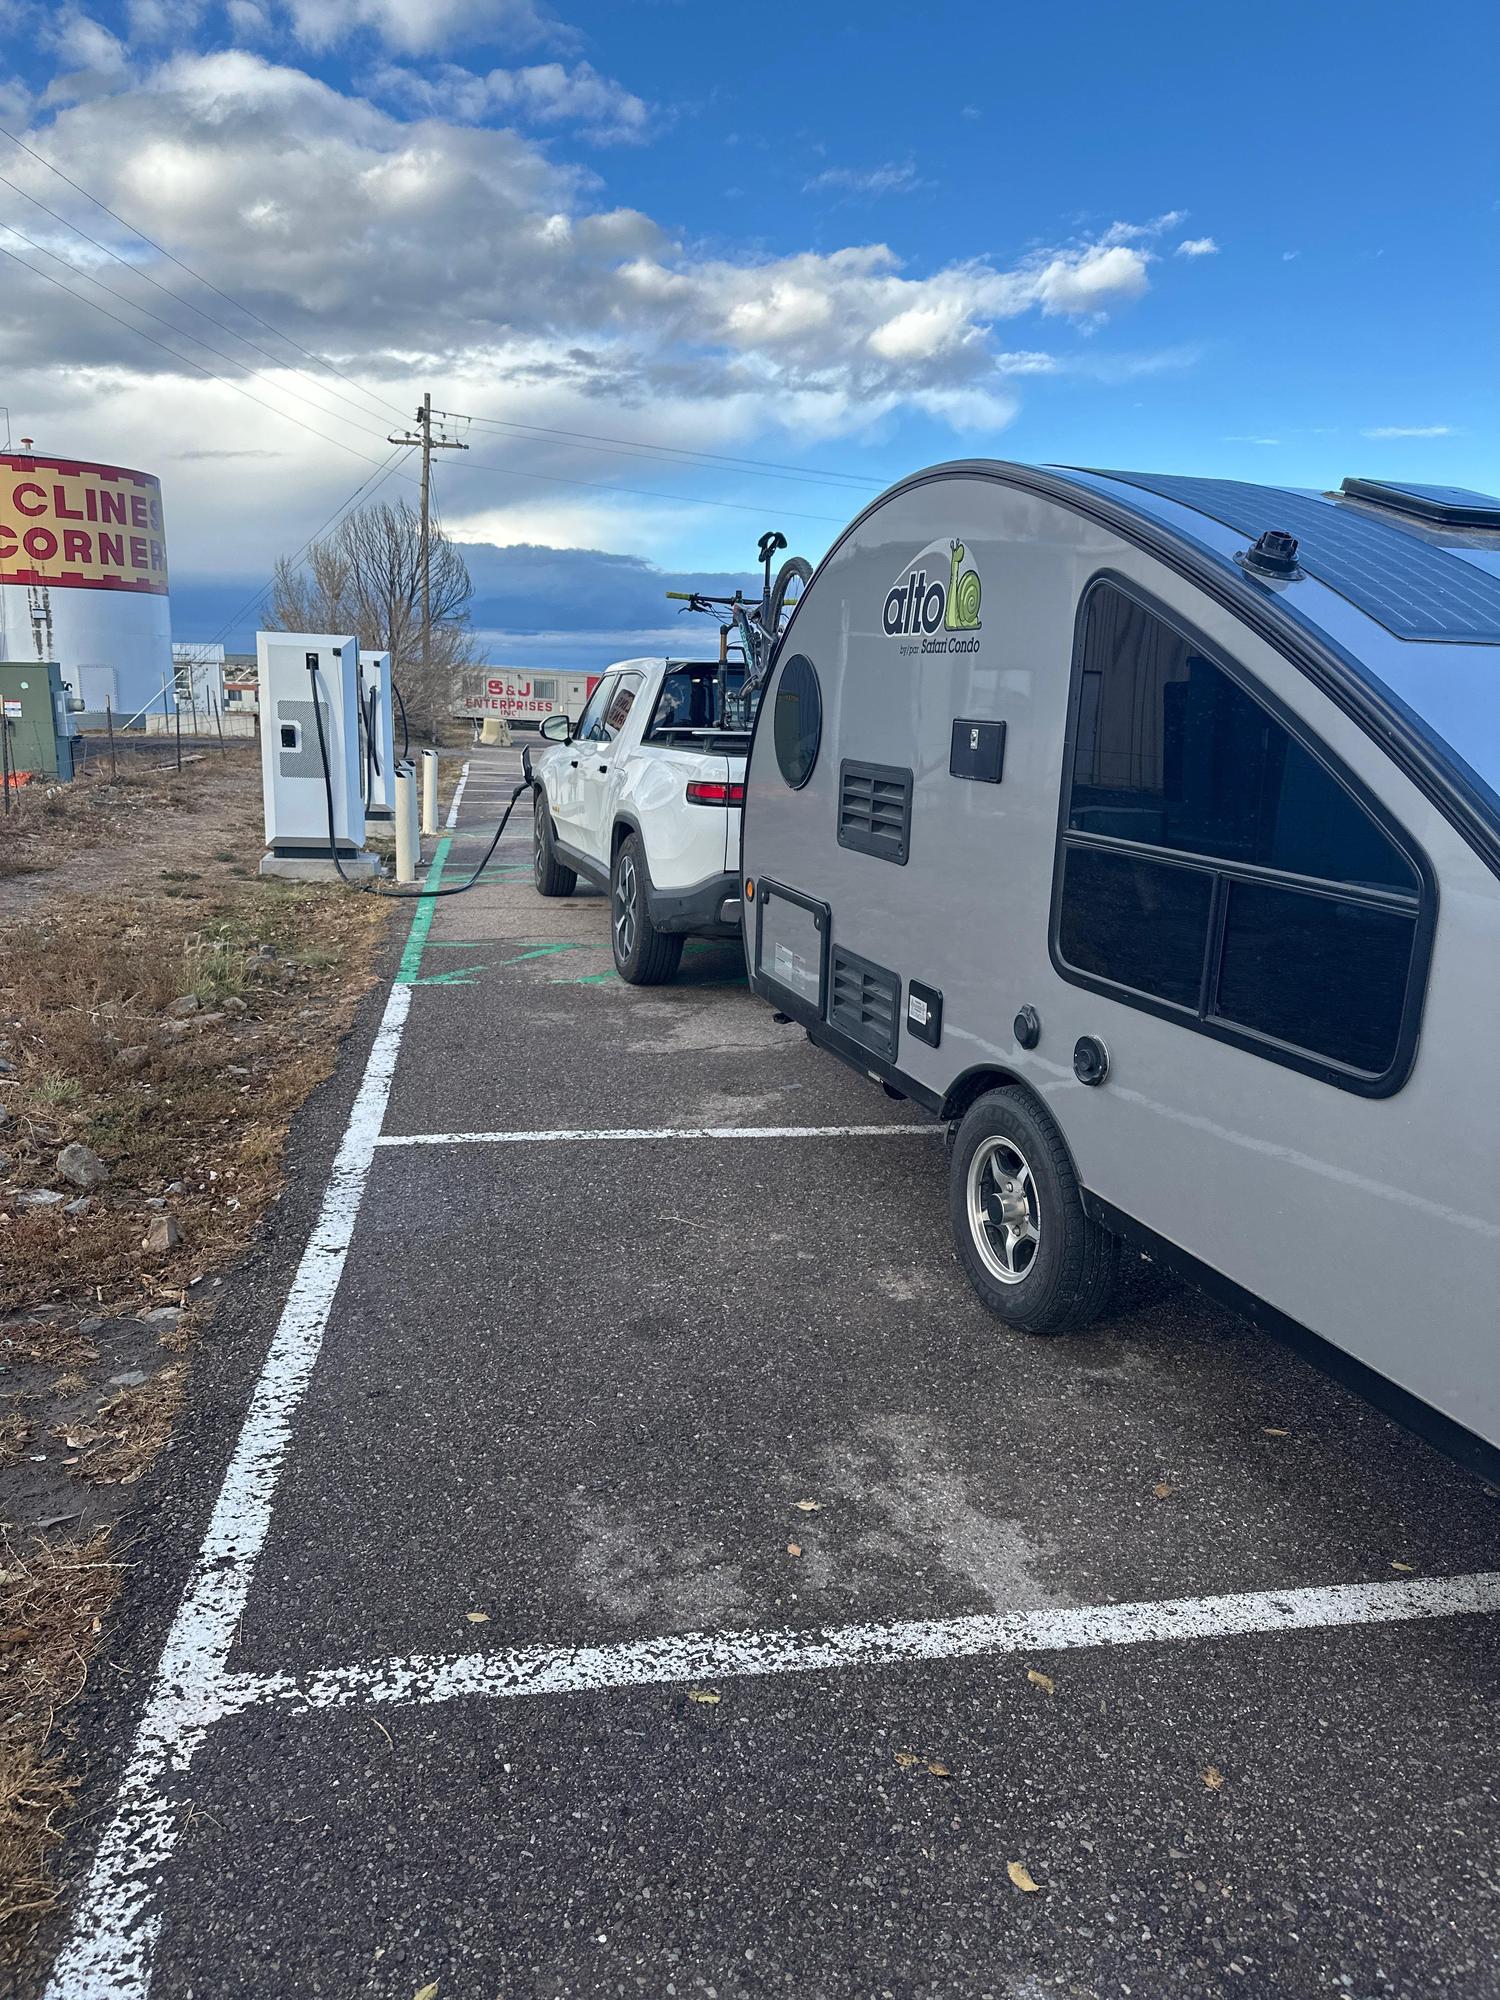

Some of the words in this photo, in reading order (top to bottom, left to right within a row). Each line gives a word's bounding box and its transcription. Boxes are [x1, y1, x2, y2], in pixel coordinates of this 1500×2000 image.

[12, 482, 161, 532] CLINES
[882, 569, 946, 637] alto
[921, 638, 947, 654] Safari
[948, 637, 980, 654] Condo
[488, 680, 503, 695] S
[506, 685, 515, 696] &
[518, 682, 530, 697] J
[464, 697, 552, 712] ENTERPRISES
